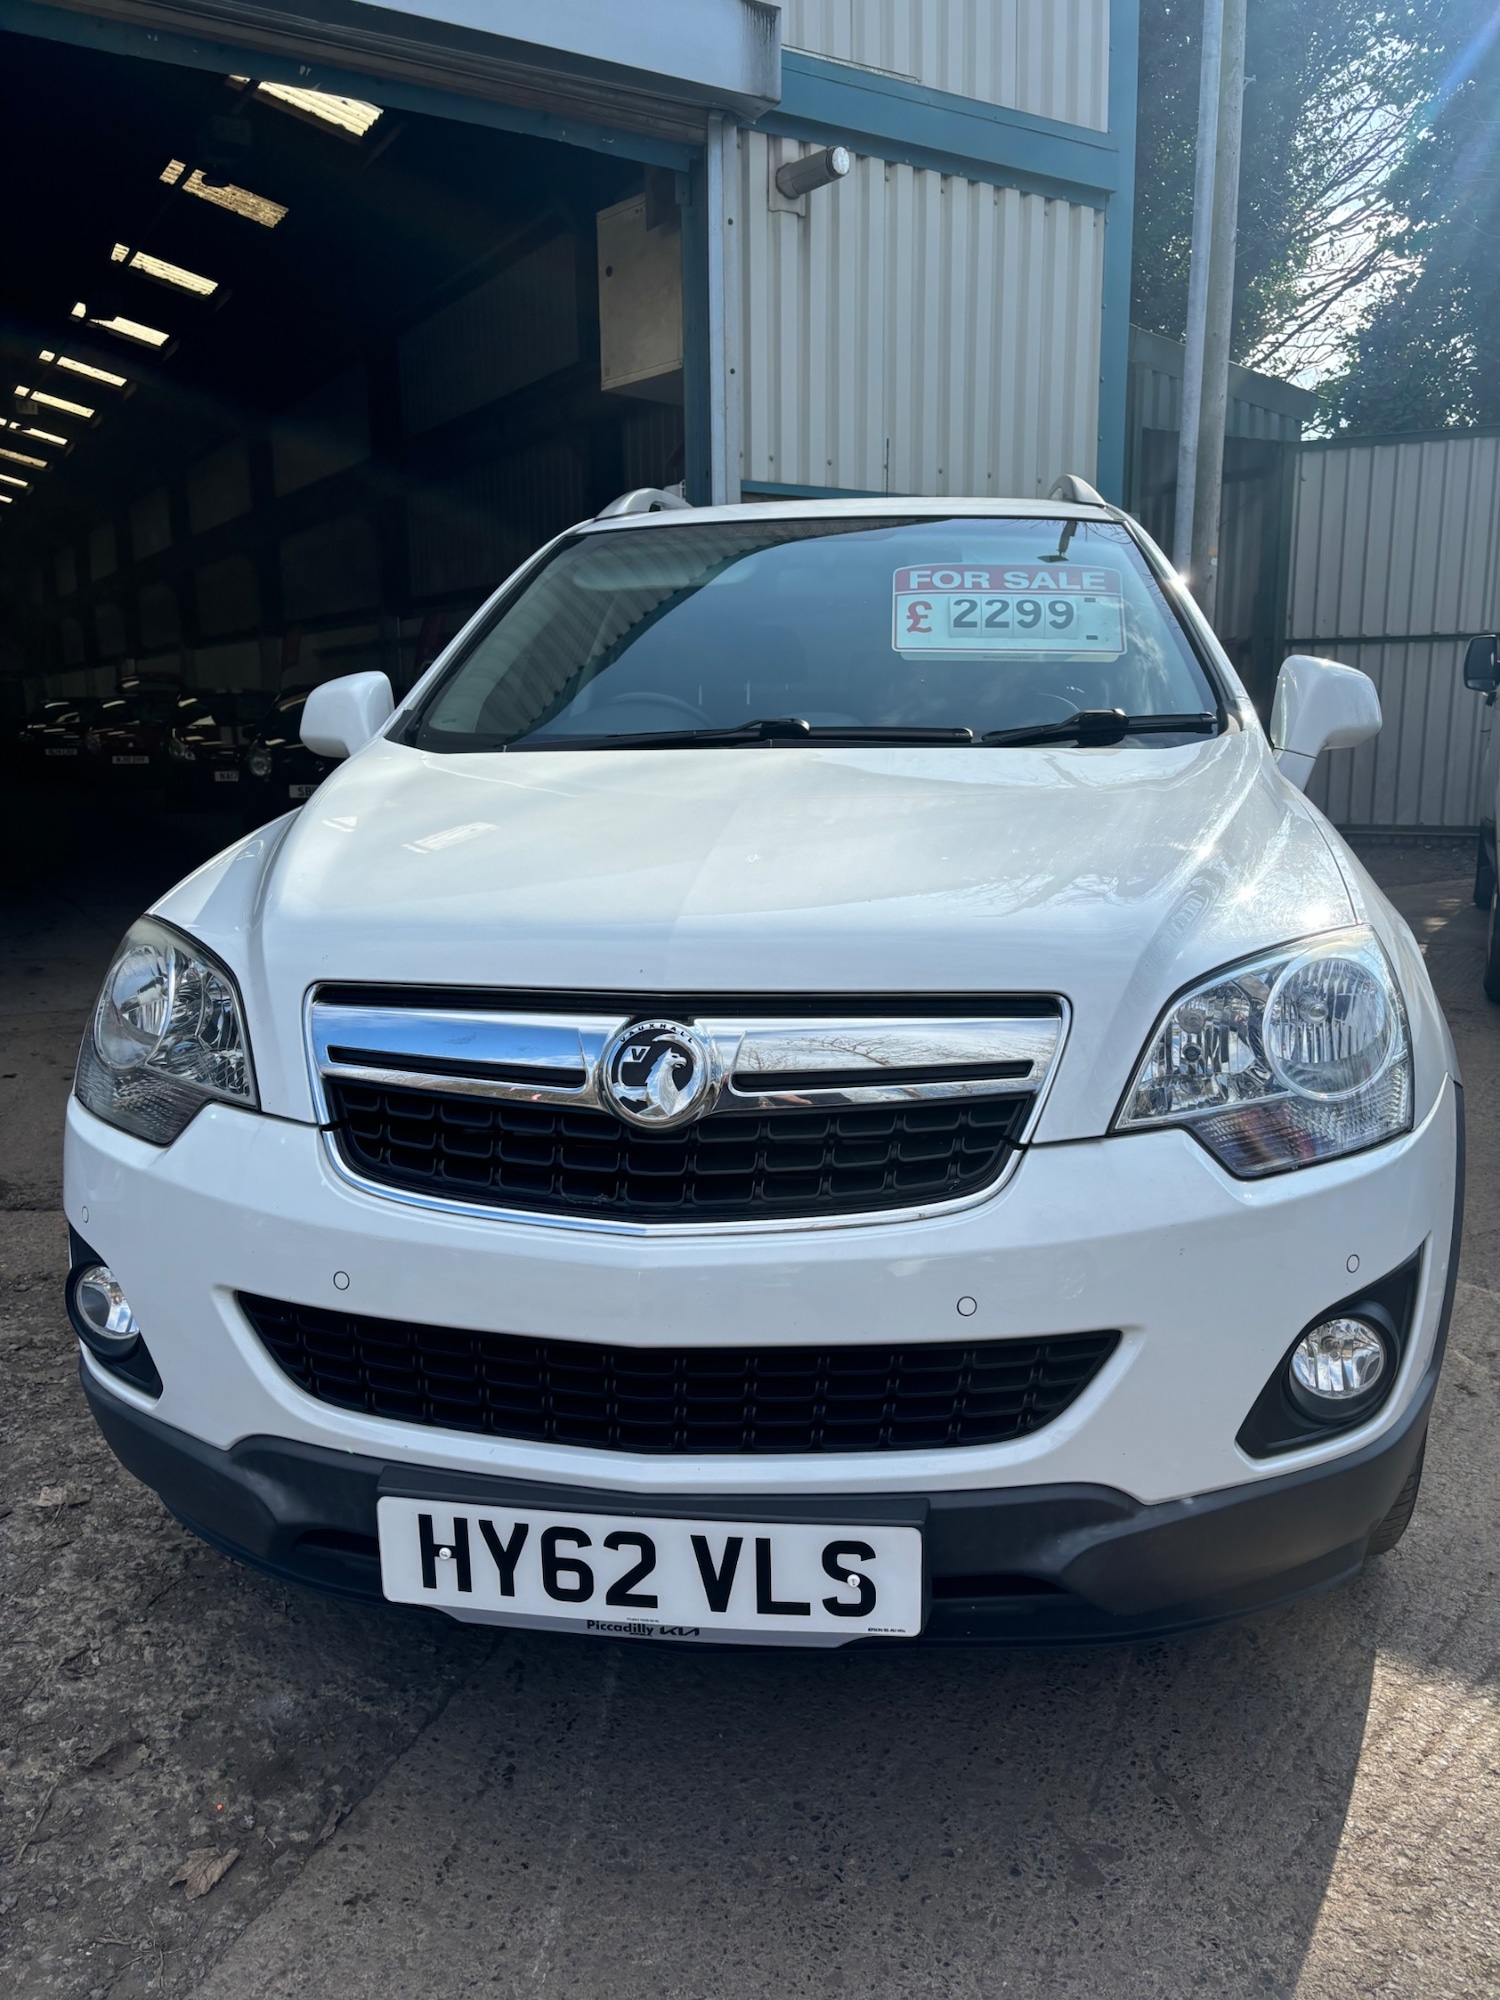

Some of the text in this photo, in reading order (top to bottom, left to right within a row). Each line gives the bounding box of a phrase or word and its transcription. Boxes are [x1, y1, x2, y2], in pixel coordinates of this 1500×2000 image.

[909, 570, 1106, 590] FOR SALE
[906, 599, 1075, 633] £ 2299
[619, 1023, 693, 1044] VAUXHALL
[418, 1513, 877, 1618] HY62 VLS
[587, 1619, 654, 1637] Piccadilly
